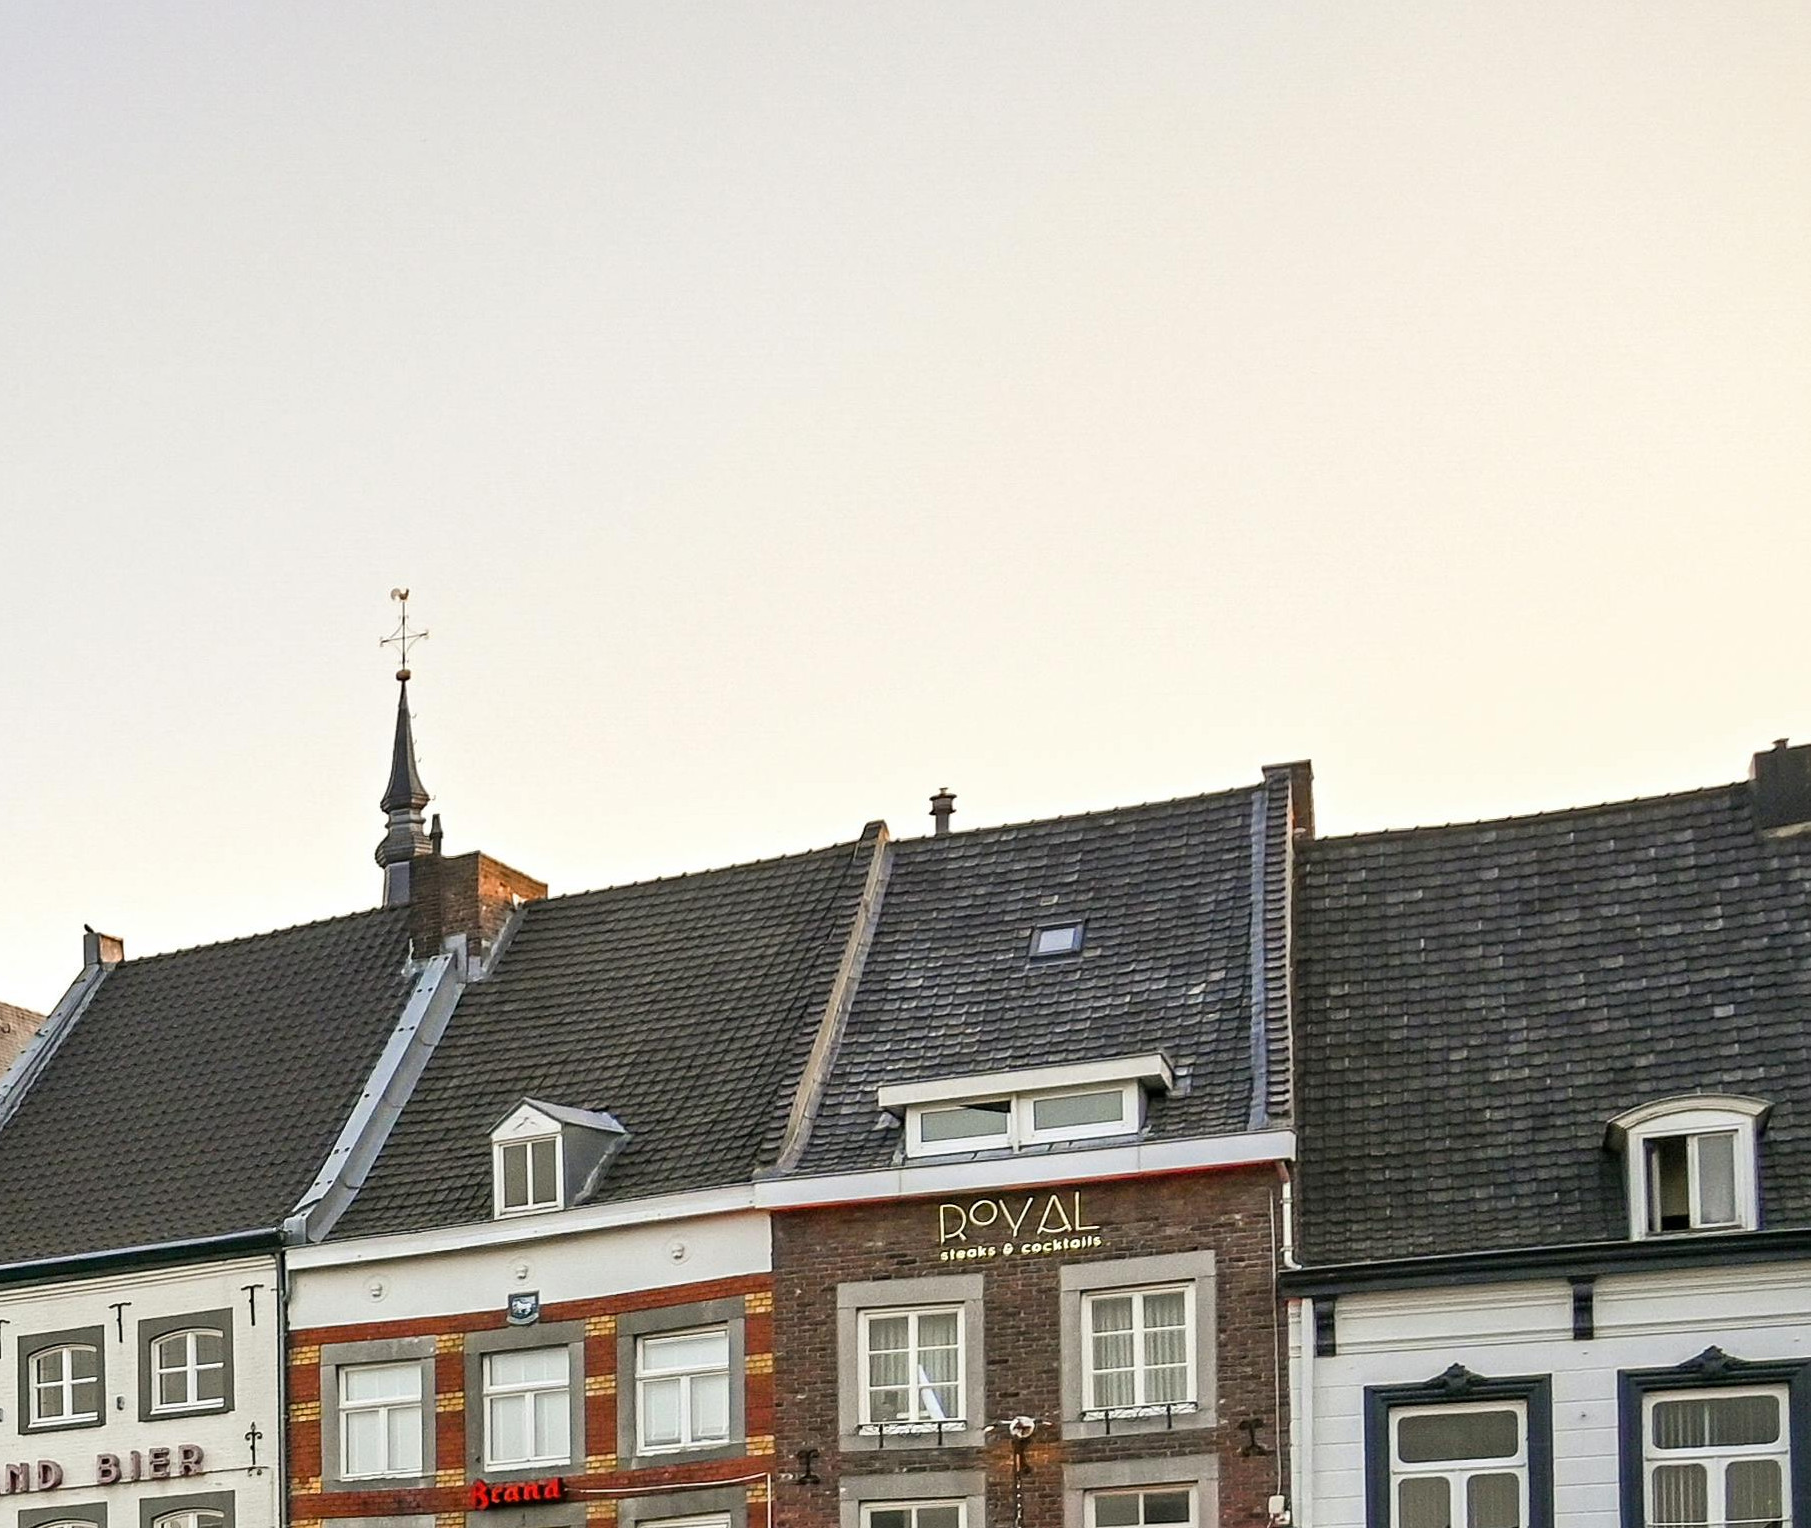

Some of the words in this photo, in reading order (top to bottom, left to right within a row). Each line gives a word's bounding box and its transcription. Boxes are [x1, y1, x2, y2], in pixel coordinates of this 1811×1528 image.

[939, 1191, 1101, 1246] ROYAL
[940, 1246, 997, 1262] steaks
[1003, 1242, 1014, 1256] &
[1021, 1235, 1102, 1255] cocktails
[96, 1443, 205, 1486] BIER
[472, 1477, 562, 1512] Brand
